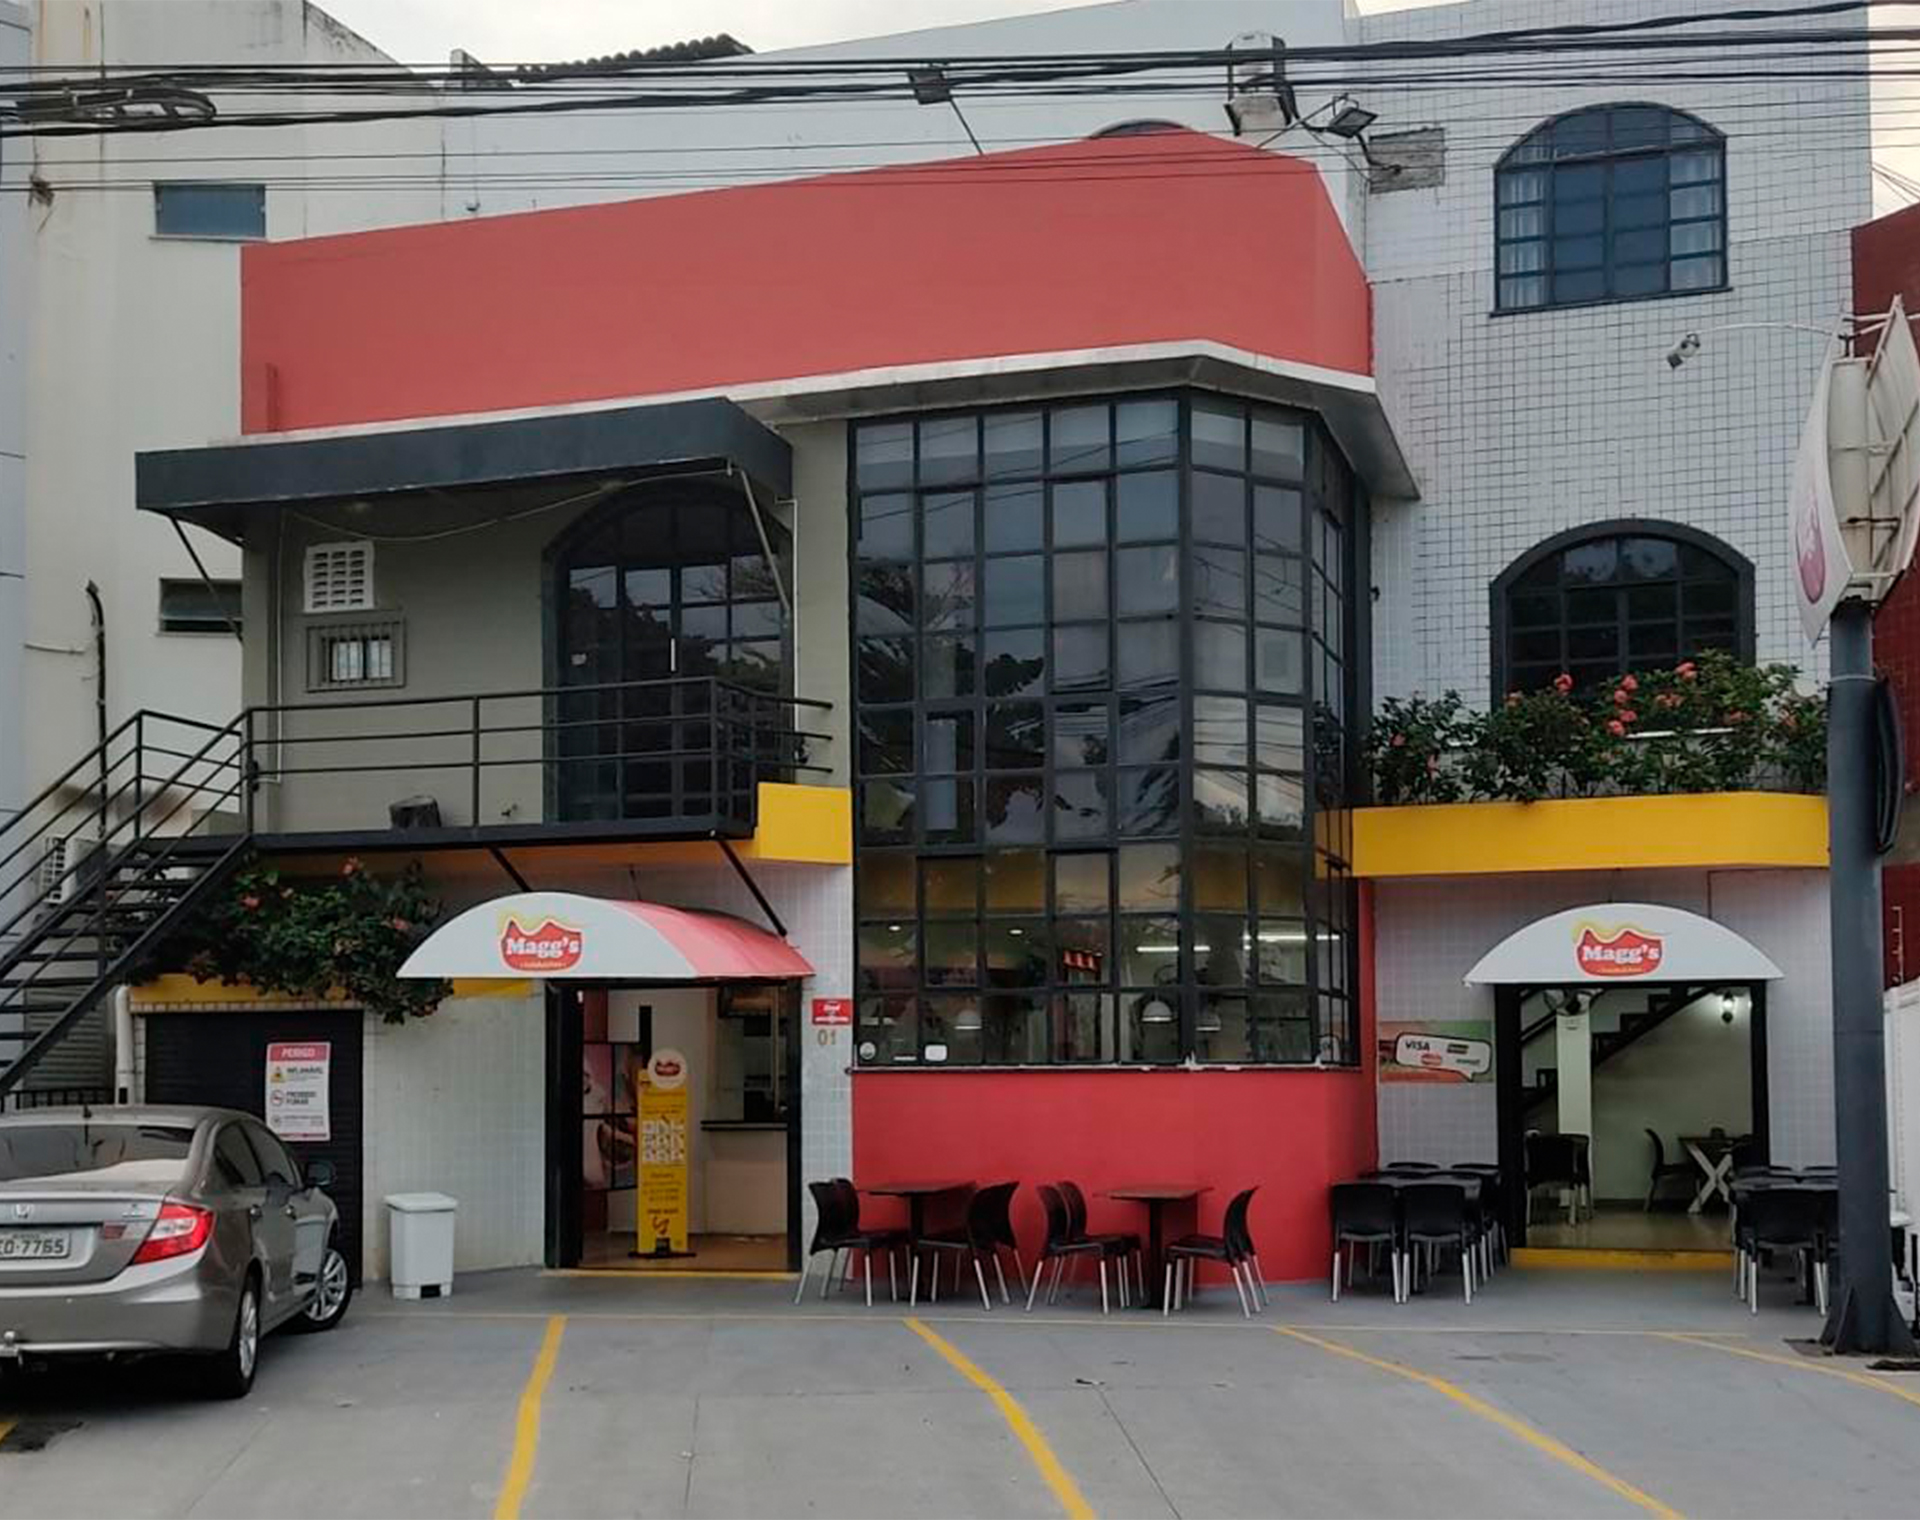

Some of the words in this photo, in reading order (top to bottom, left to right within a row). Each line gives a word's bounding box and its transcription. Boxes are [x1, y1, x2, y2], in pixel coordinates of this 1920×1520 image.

[506, 937, 579, 958] Magg's
[1582, 944, 1659, 965] Magg's
[817, 1029, 836, 1045] 01
[1405, 1041, 1430, 1051] VISA
